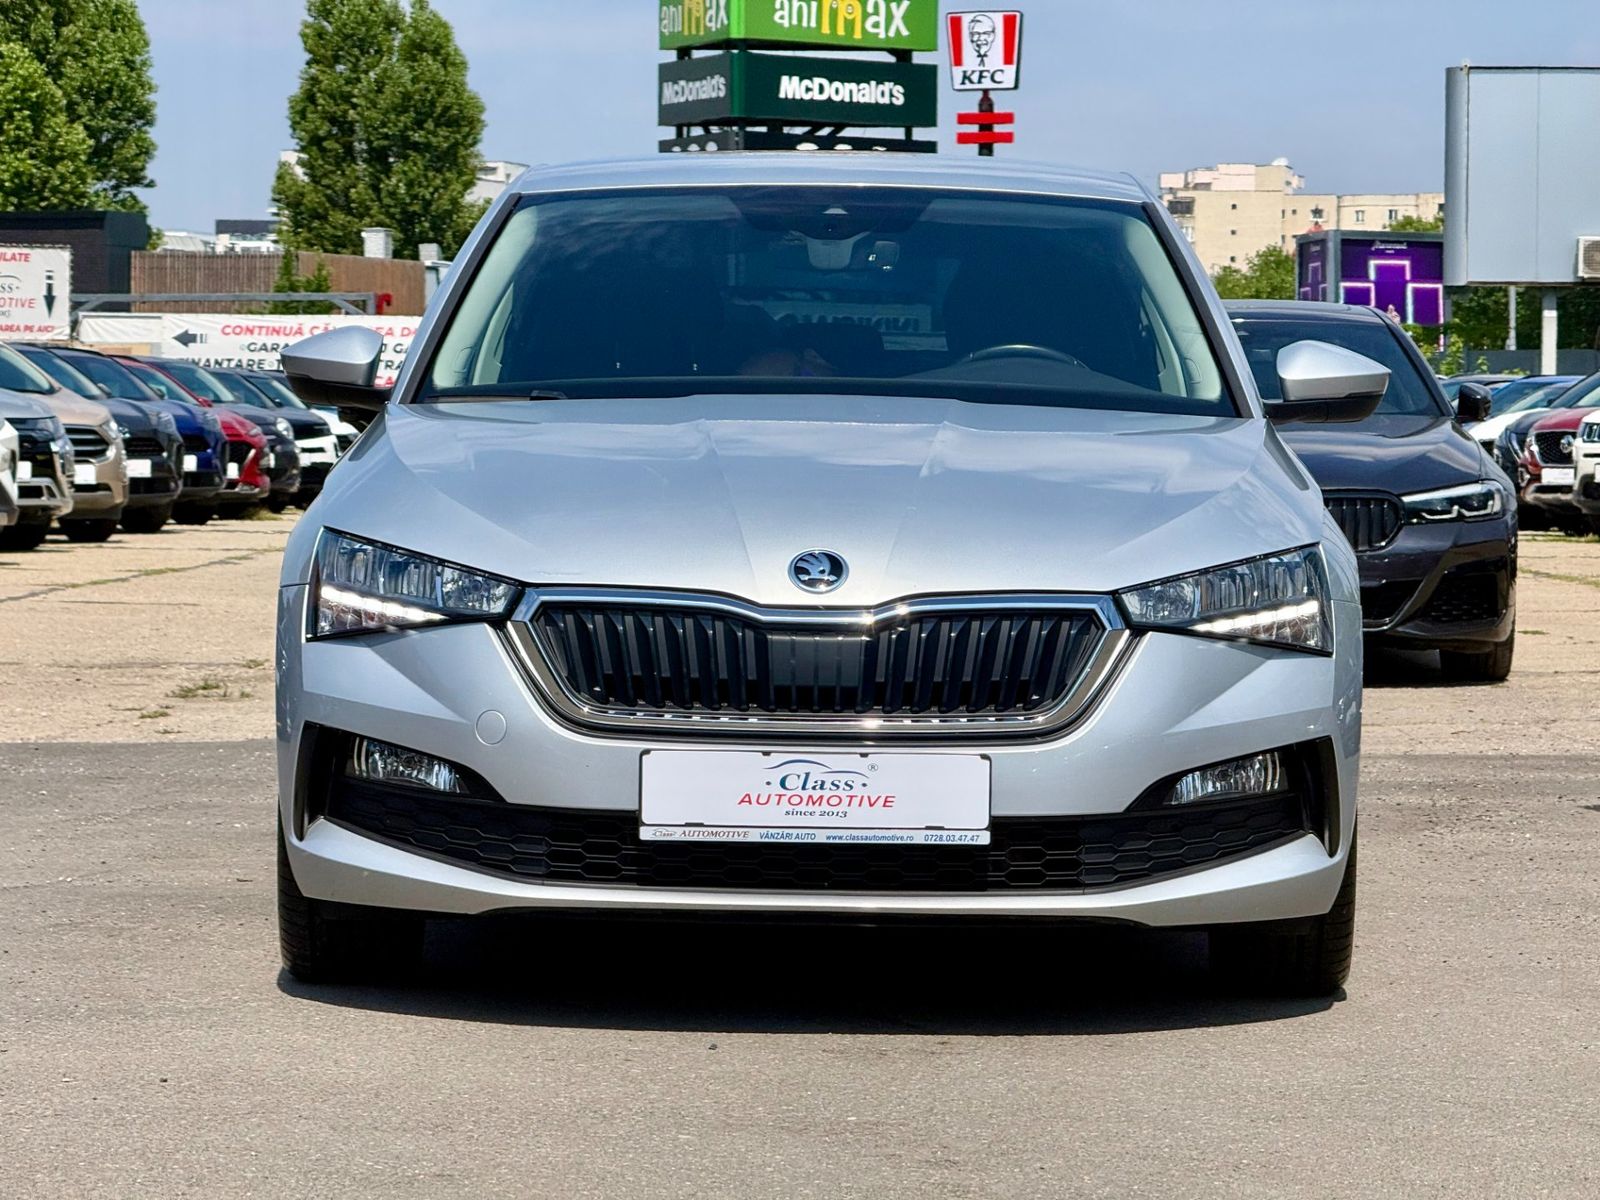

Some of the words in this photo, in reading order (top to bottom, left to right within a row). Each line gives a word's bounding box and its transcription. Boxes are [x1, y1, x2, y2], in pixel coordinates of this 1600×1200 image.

[959, 68, 1006, 86] KFC
[661, 74, 727, 106] McDonald's
[778, 75, 906, 106] McDonald's
[221, 323, 304, 337] CONTINUĂ
[779, 771, 855, 792] Class
[737, 792, 896, 808] AUTOMOTIVE
[784, 809, 816, 818] since
[818, 811, 848, 819] 2013
[680, 829, 750, 840] AUTOMOTIVE
[794, 832, 816, 841] AUTO
[825, 833, 915, 844] www.classautomotive.ro
[924, 834, 980, 843] 0728.03.47.47
